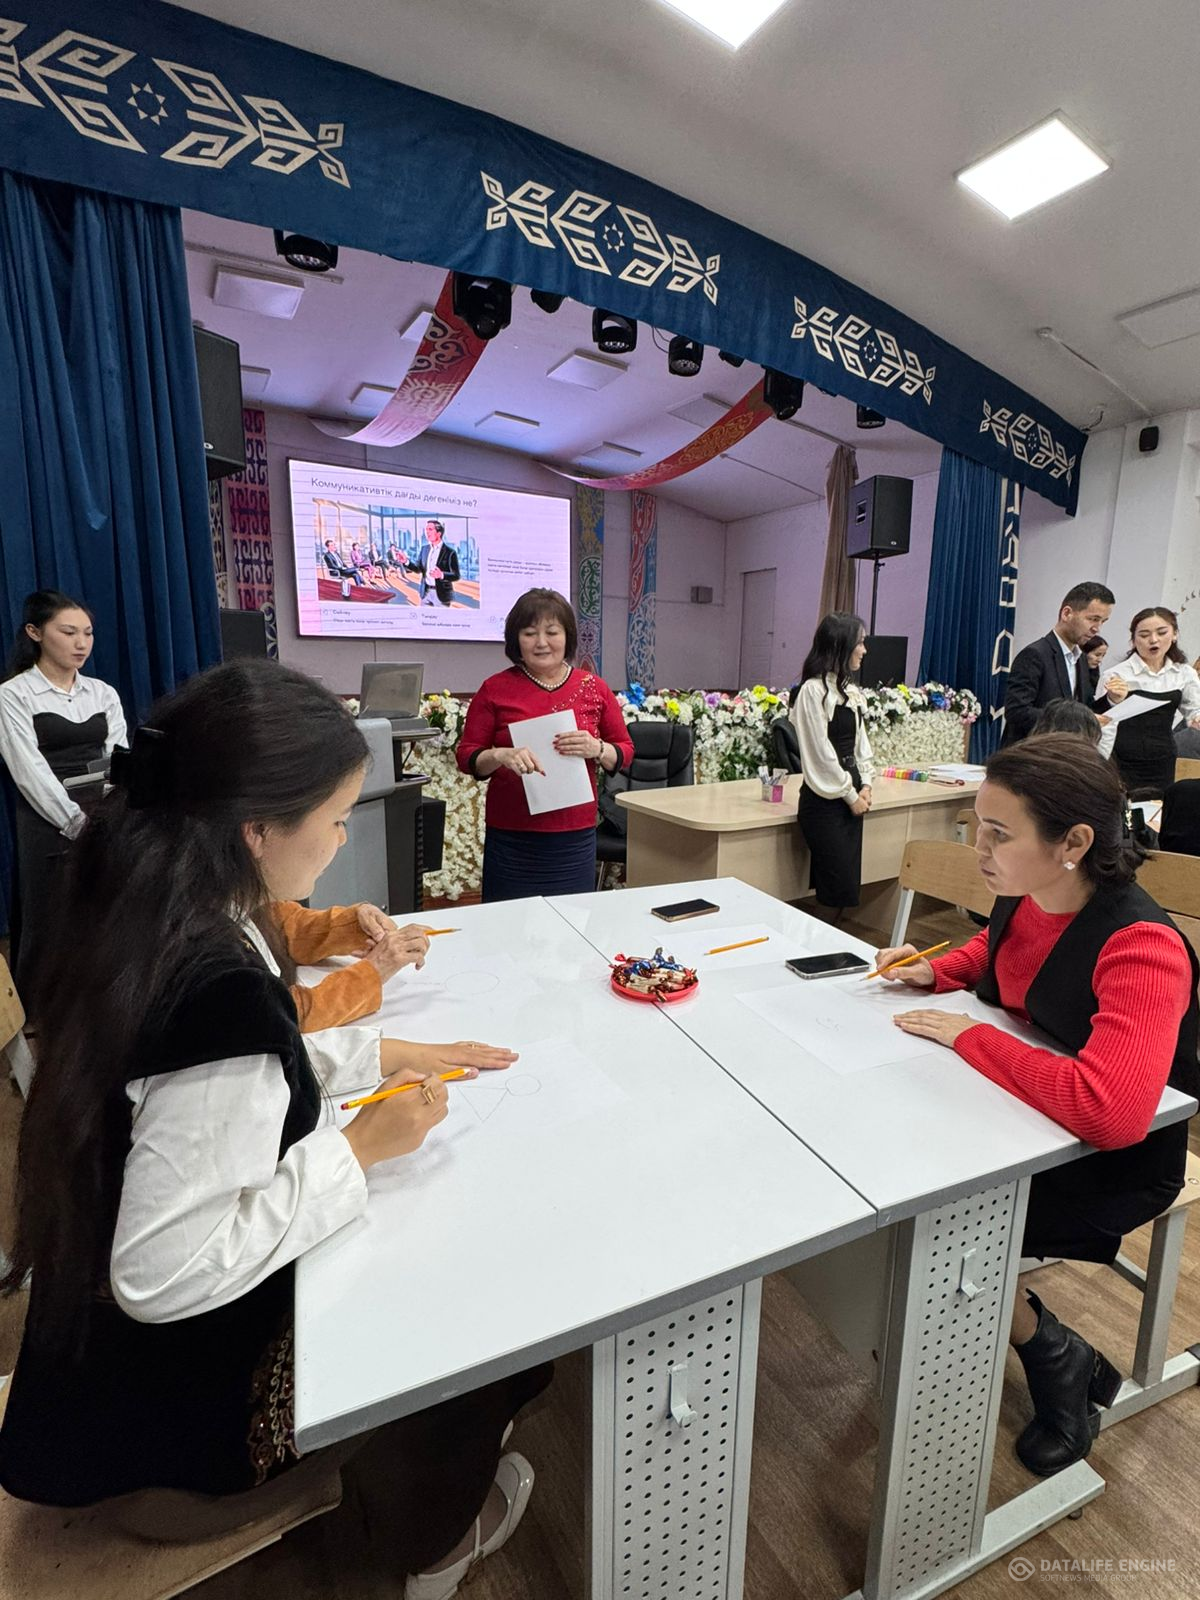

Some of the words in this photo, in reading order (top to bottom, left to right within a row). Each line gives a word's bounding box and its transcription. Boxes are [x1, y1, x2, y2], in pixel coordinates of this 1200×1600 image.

[311, 477, 393, 497] Коммуникативтік
[423, 494, 462, 506] дегеніміз
[463, 499, 478, 508] не?
